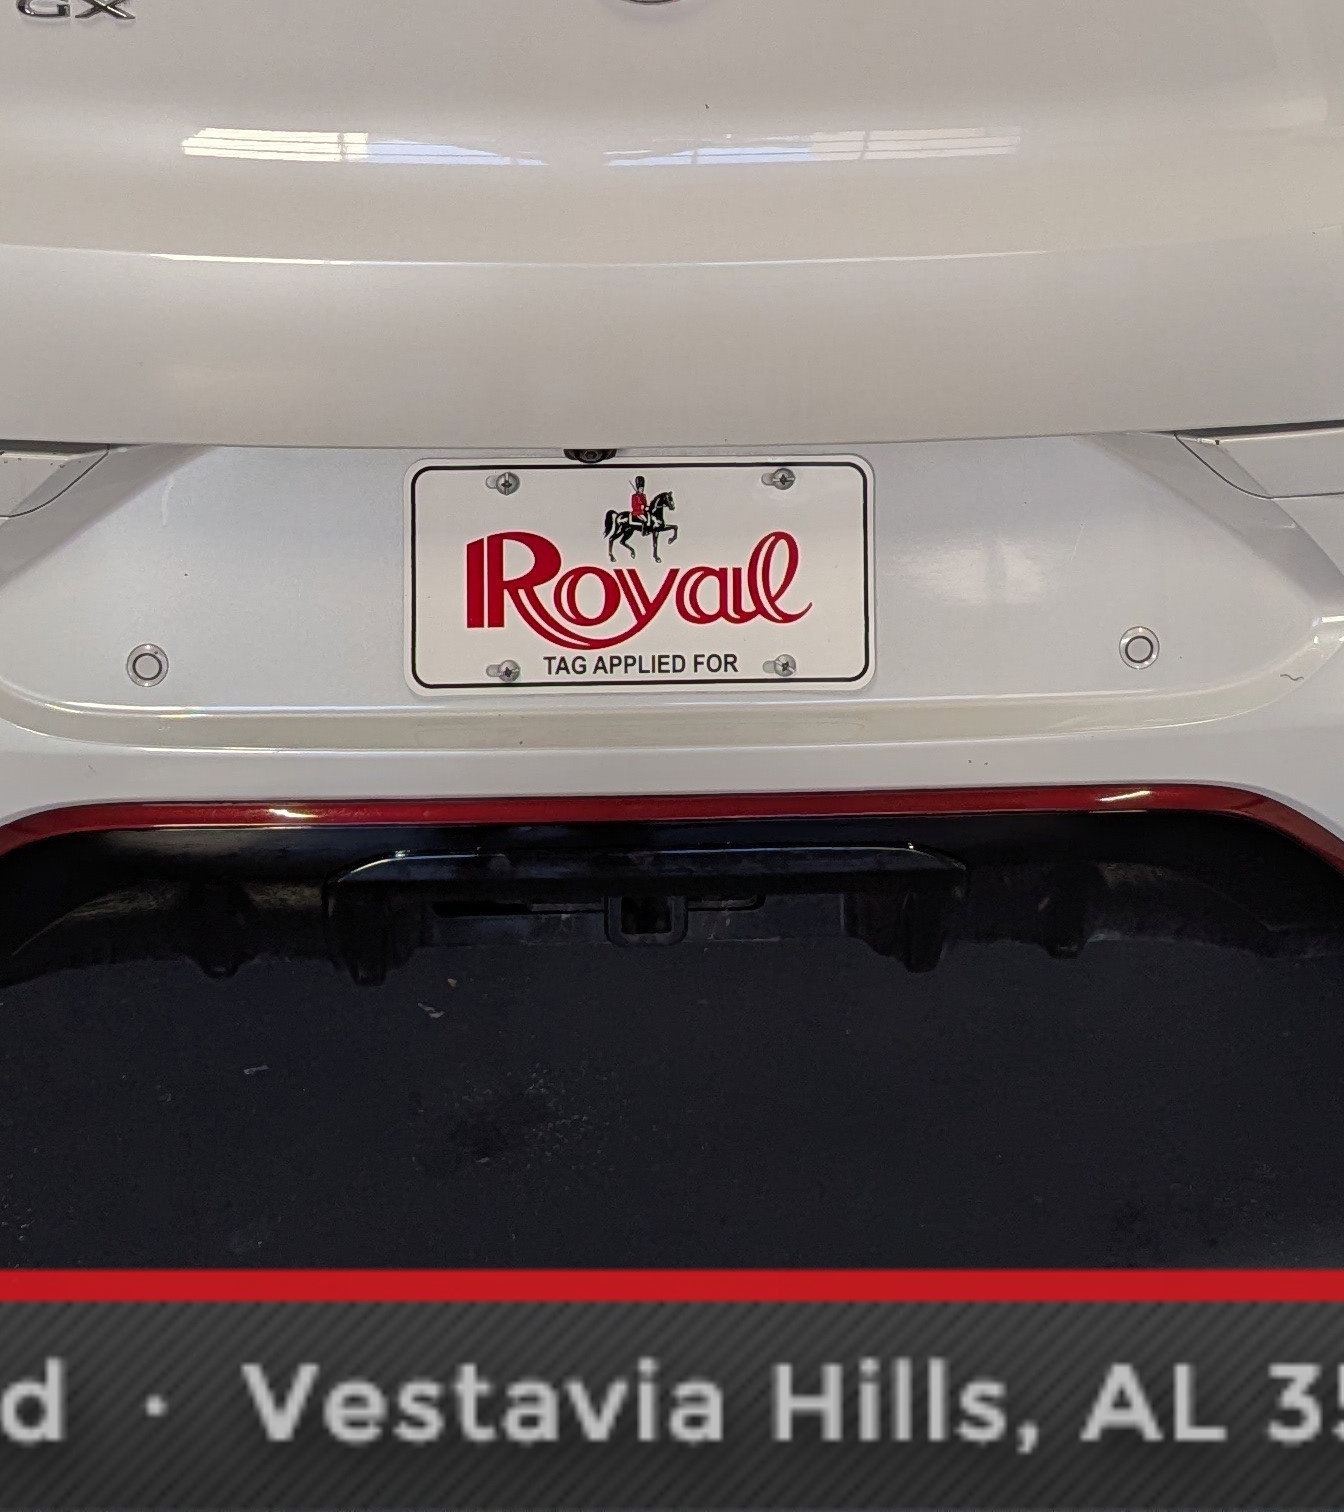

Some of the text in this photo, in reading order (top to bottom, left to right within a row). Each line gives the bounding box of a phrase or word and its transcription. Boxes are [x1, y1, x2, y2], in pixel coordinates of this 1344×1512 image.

[466, 531, 813, 650] Royal
[543, 653, 739, 675] TAG APPLIED FOR
